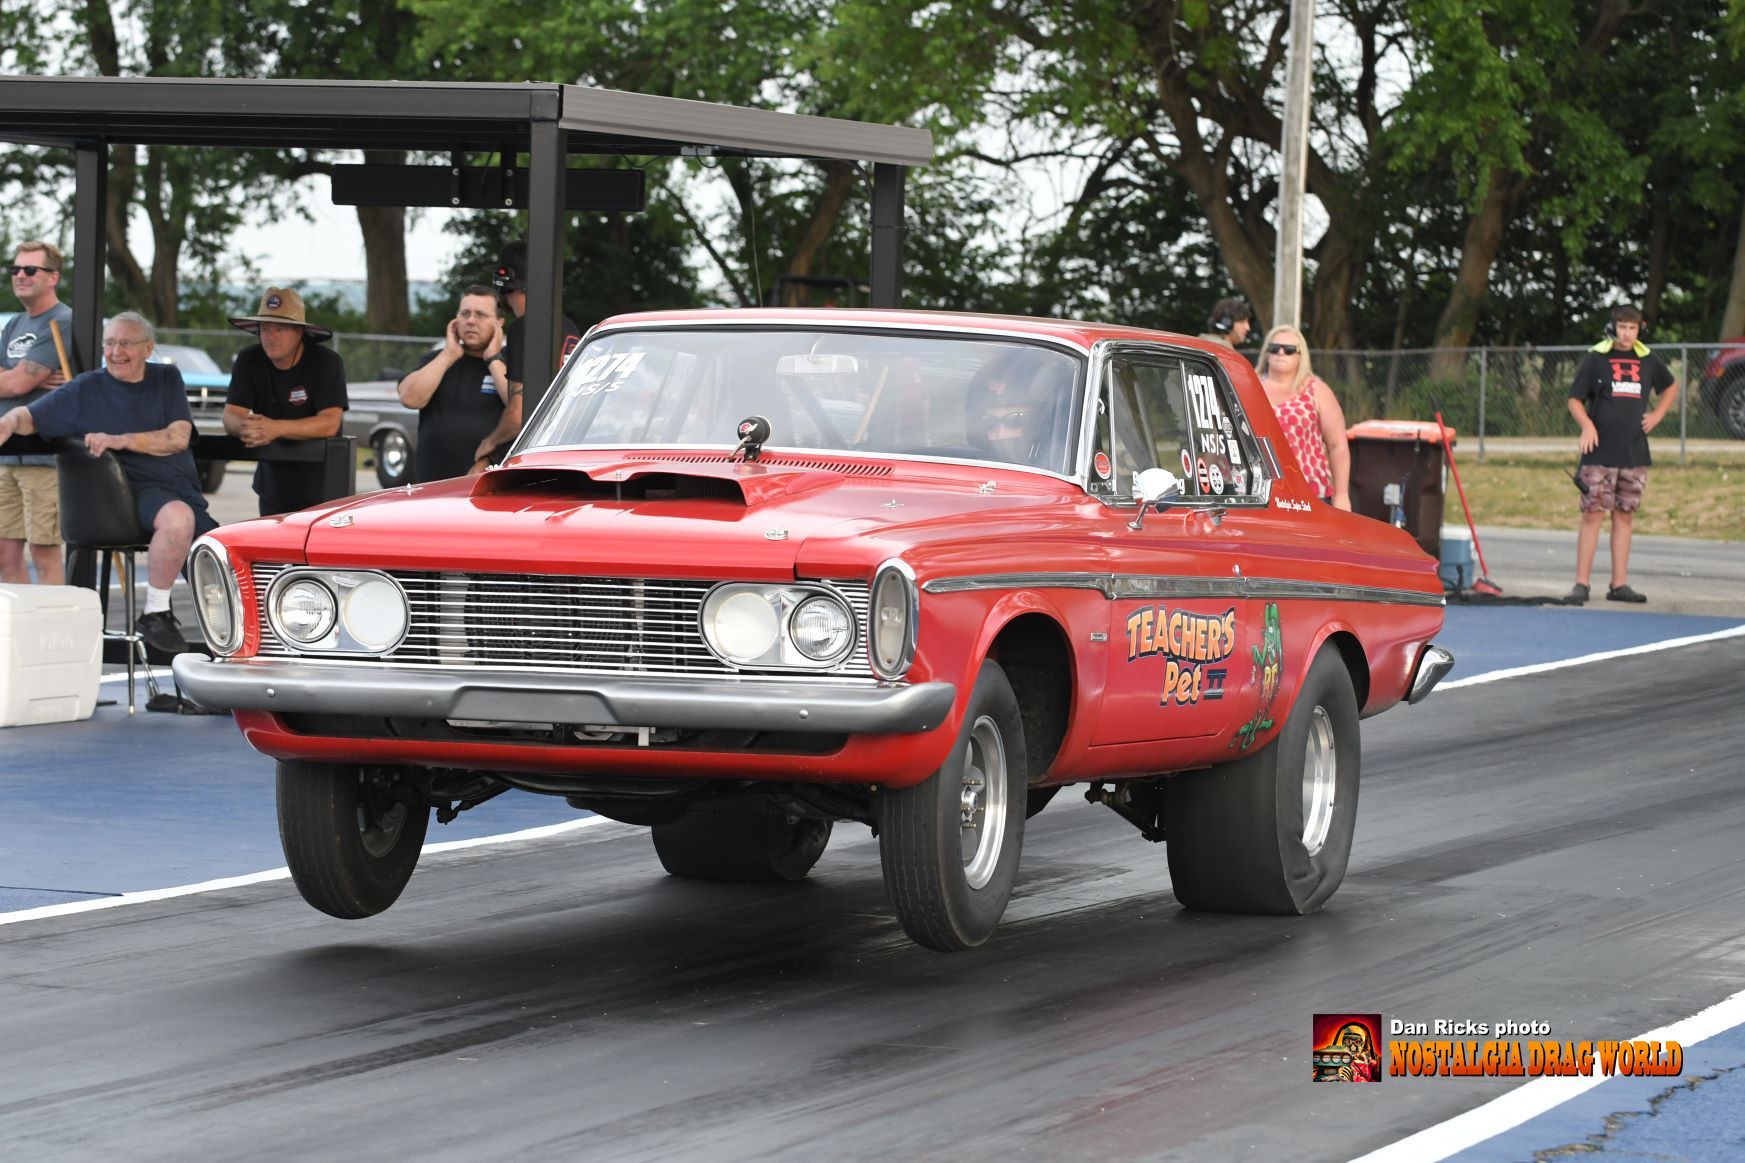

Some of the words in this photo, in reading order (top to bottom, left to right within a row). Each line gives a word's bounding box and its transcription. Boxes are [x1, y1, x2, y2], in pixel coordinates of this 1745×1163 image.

[1187, 374, 1222, 430] 1274
[1201, 433, 1226, 456] NS/S
[1126, 605, 1235, 664] TEACHER'S
[1160, 657, 1203, 707] Pet
[1203, 669, 1227, 700] II
